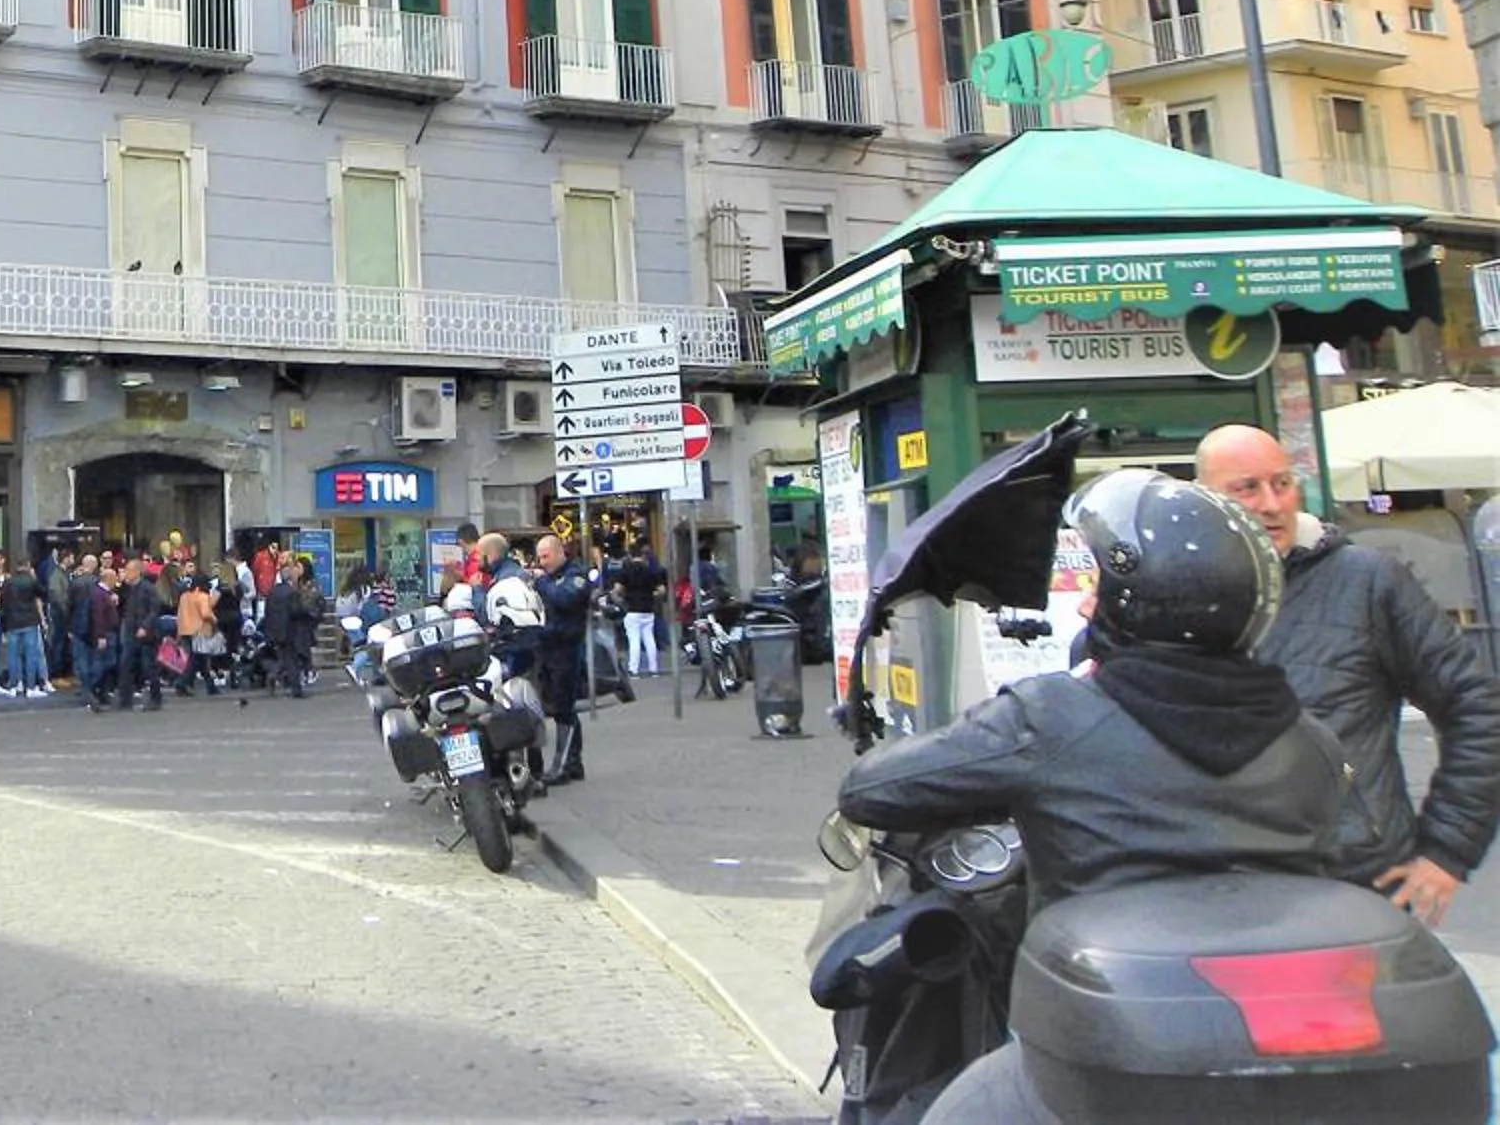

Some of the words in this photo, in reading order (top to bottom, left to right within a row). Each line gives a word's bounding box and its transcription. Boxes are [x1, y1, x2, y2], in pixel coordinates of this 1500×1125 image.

[1007, 264, 1090, 286] TICKET
[1098, 261, 1166, 283] POINT
[1010, 290, 1114, 306] TOURIST
[1120, 288, 1171, 303] BUS
[587, 330, 639, 348] DANTE
[1046, 337, 1132, 360] TOURIST
[1144, 336, 1185, 358] BUS
[601, 359, 623, 372] Via
[628, 354, 675, 370] Toledo
[602, 383, 677, 400] Funicolare
[584, 416, 629, 428] Quartieri
[634, 410, 680, 426] Spagnoli
[365, 473, 418, 502] TIM
[593, 470, 611, 491] P
[1057, 554, 1094, 571] BUS
